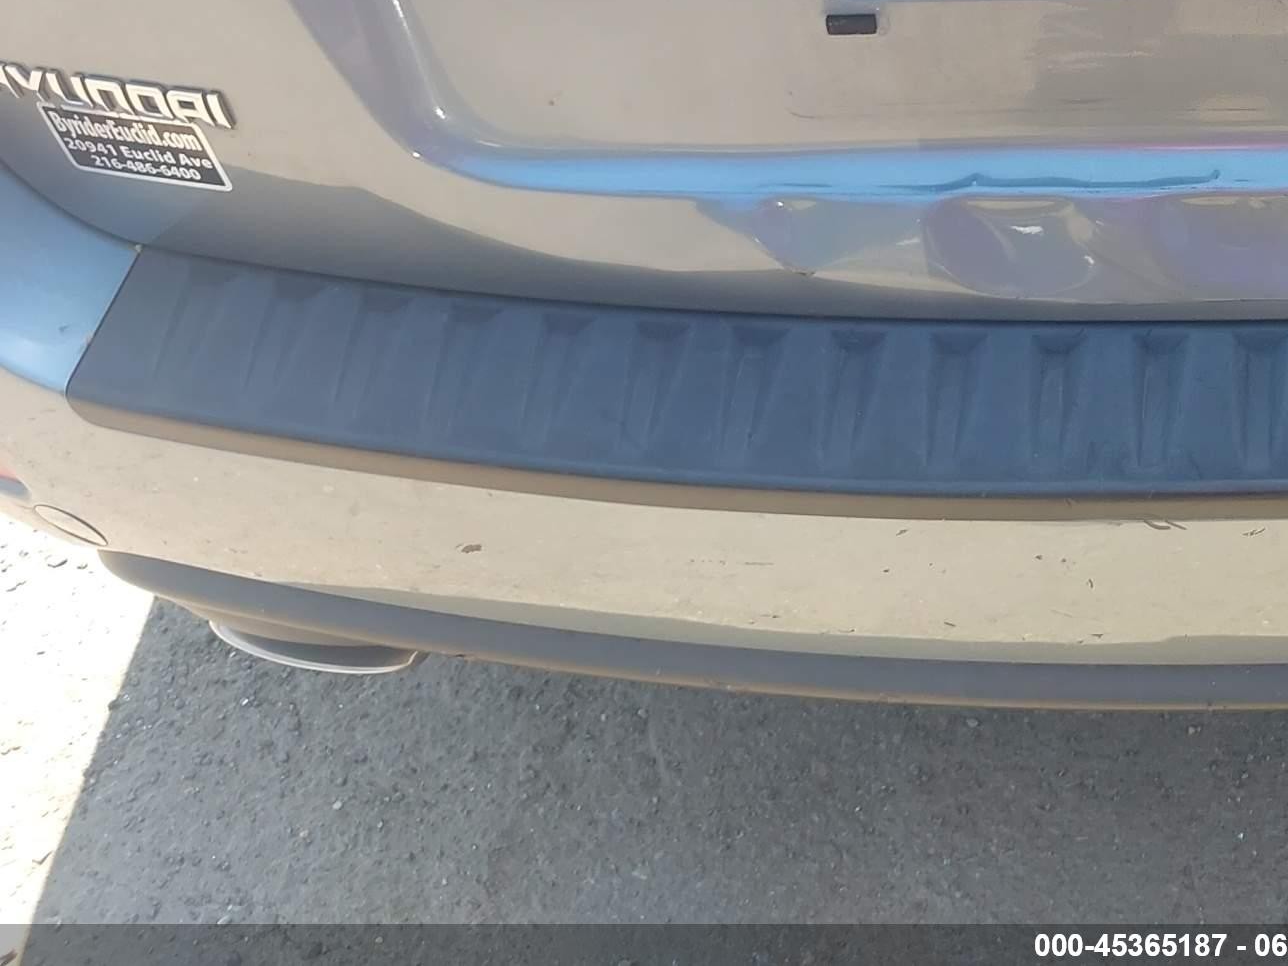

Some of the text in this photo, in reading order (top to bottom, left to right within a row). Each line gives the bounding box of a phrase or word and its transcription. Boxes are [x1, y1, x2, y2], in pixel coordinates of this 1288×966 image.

[49, 111, 203, 152] ByriderEuclid.com
[65, 138, 213, 170] 20941 Euclid Ave
[93, 154, 201, 181] 216-486-6400
